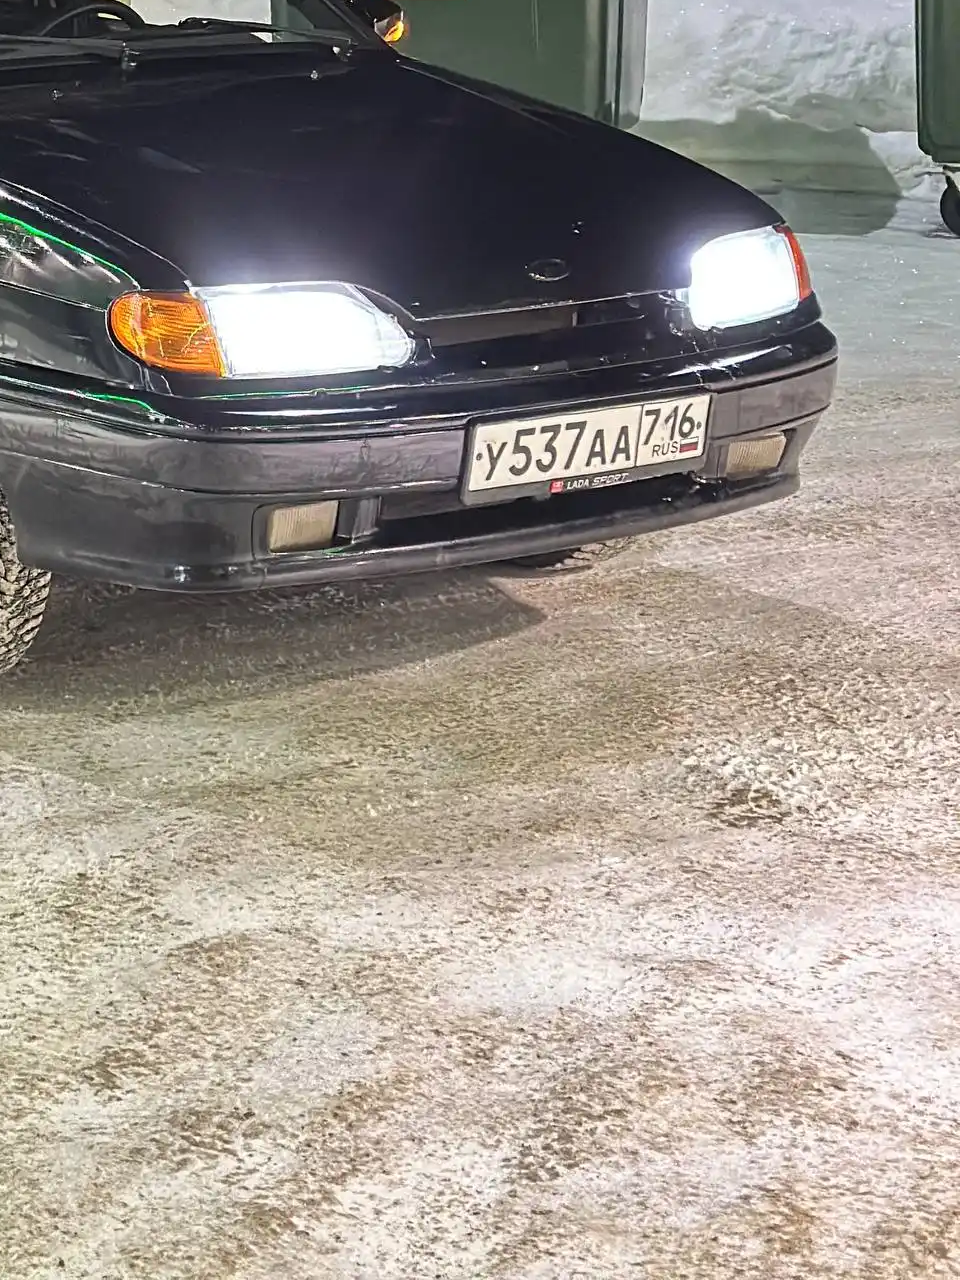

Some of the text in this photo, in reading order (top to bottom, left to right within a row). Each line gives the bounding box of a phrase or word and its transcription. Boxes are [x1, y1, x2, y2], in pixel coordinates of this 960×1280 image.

[643, 403, 696, 446] 716
[651, 440, 679, 458] RUS
[566, 472, 629, 491] LADA SPORT
